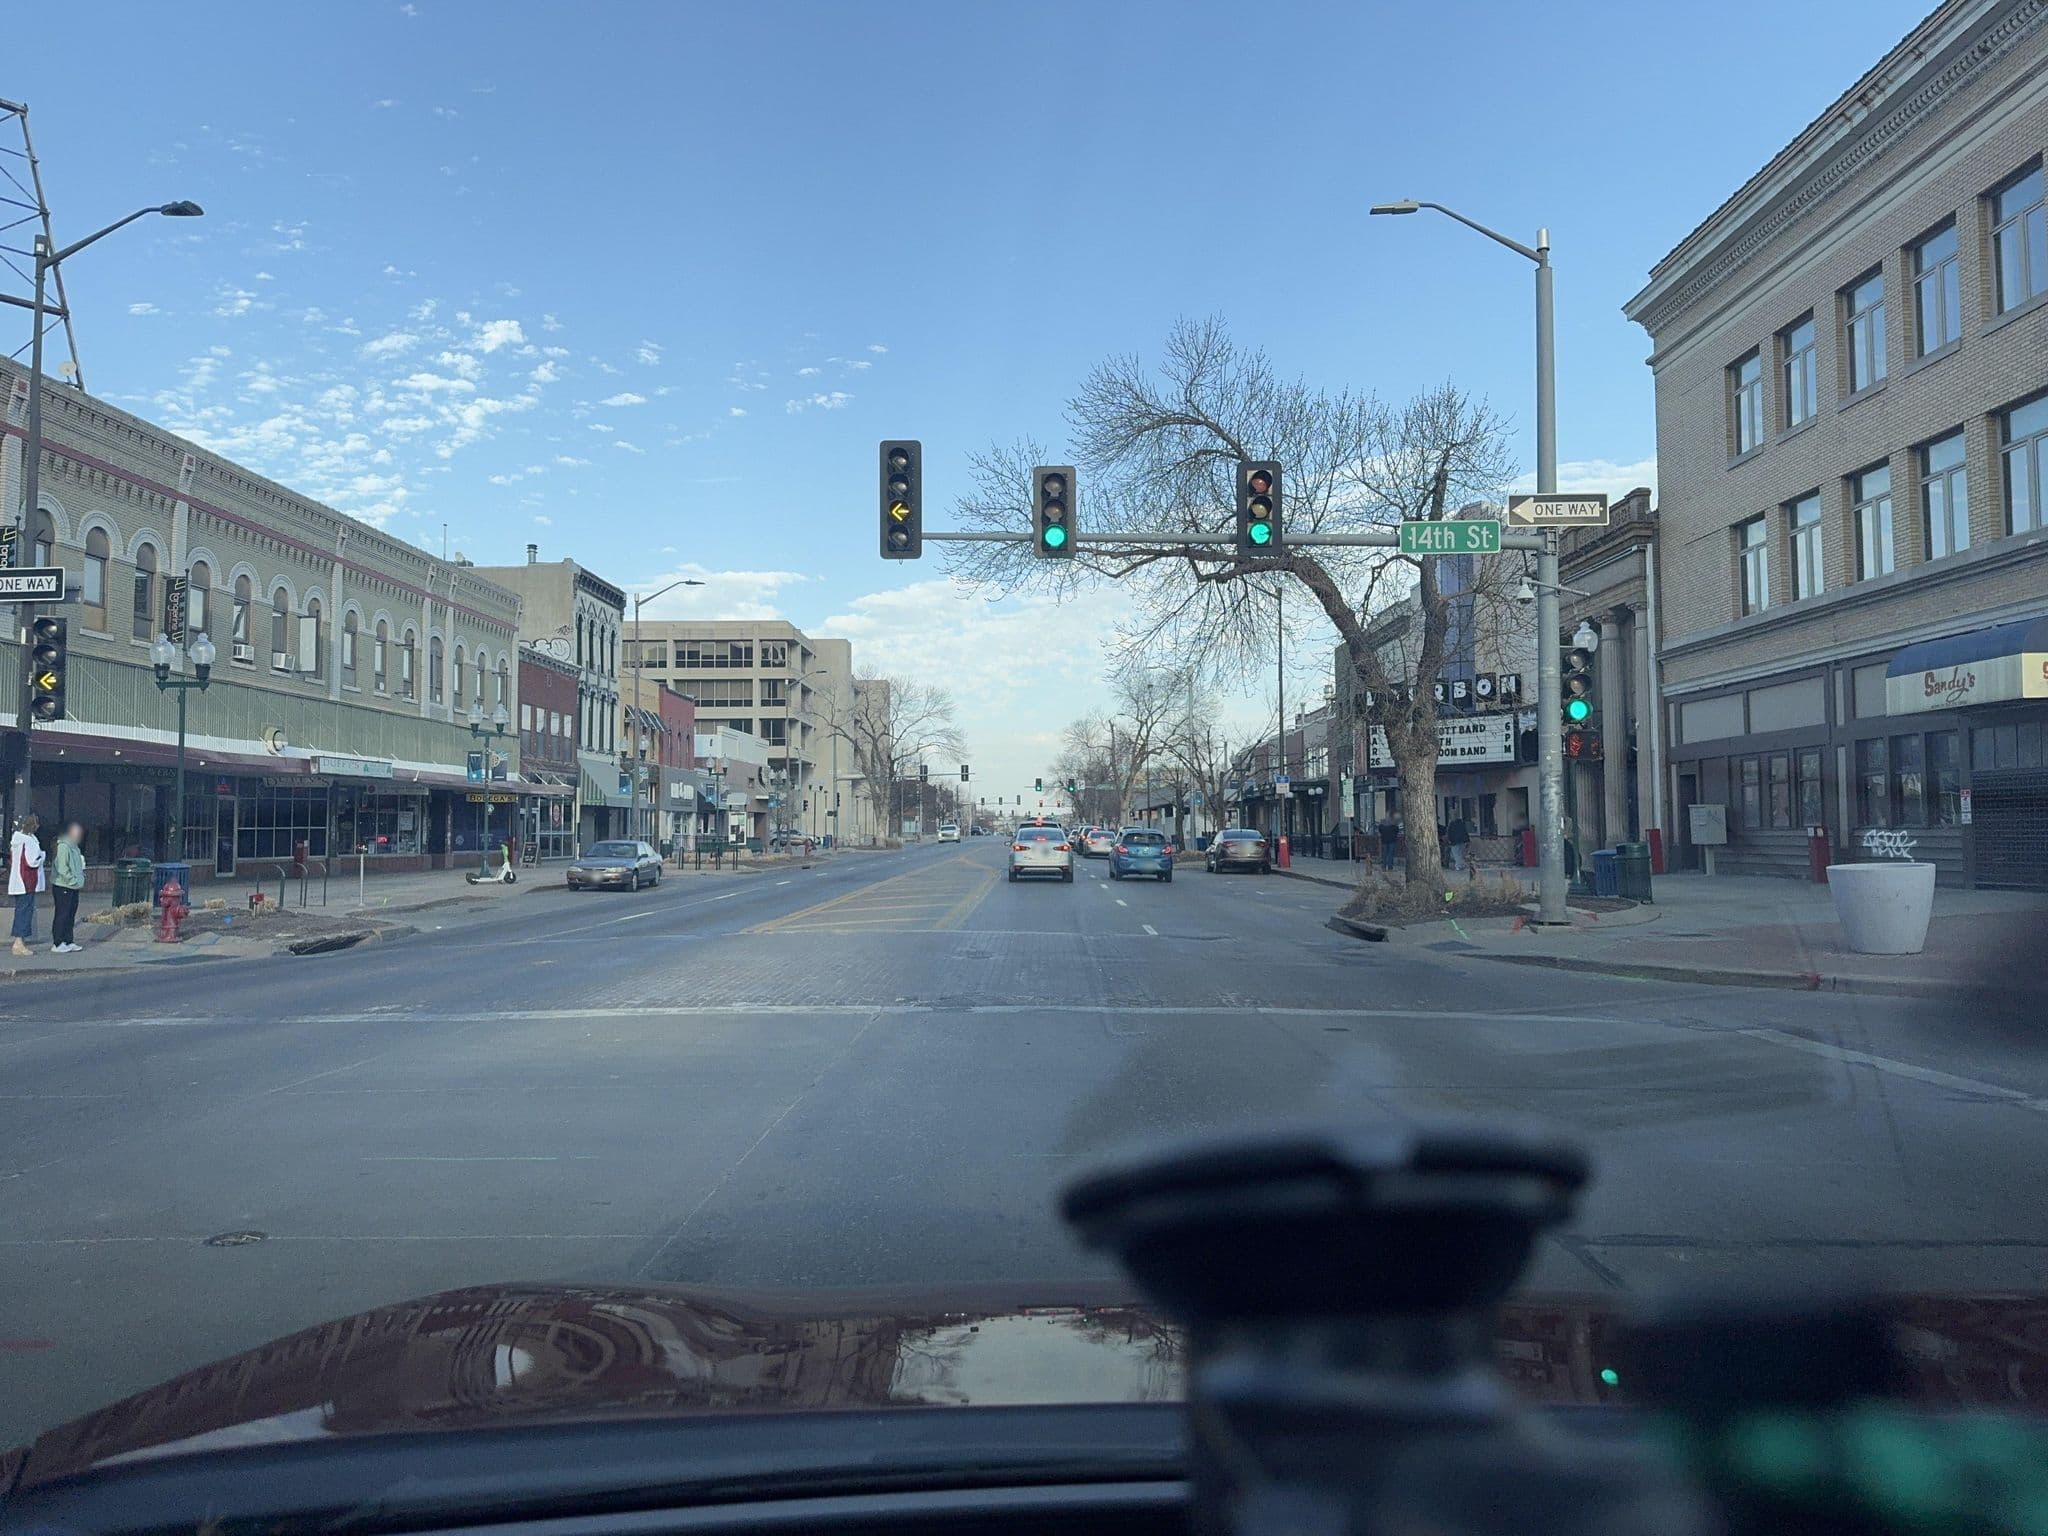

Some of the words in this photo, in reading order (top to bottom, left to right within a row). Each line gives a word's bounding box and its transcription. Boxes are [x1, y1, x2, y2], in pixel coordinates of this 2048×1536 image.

[1534, 503, 1563, 516] ONE
[1568, 503, 1597, 516] WAY
[1409, 525, 1455, 550] 14th
[1467, 525, 1490, 549] St
[26, 578, 54, 590] WAY
[1924, 666, 1976, 703] Sandy's
[1459, 723, 1486, 734] BAND
[1439, 736, 1452, 746] TH
[1438, 747, 1458, 757] OOM
[1460, 746, 1486, 756] BAND
[1371, 757, 1380, 766] 26
